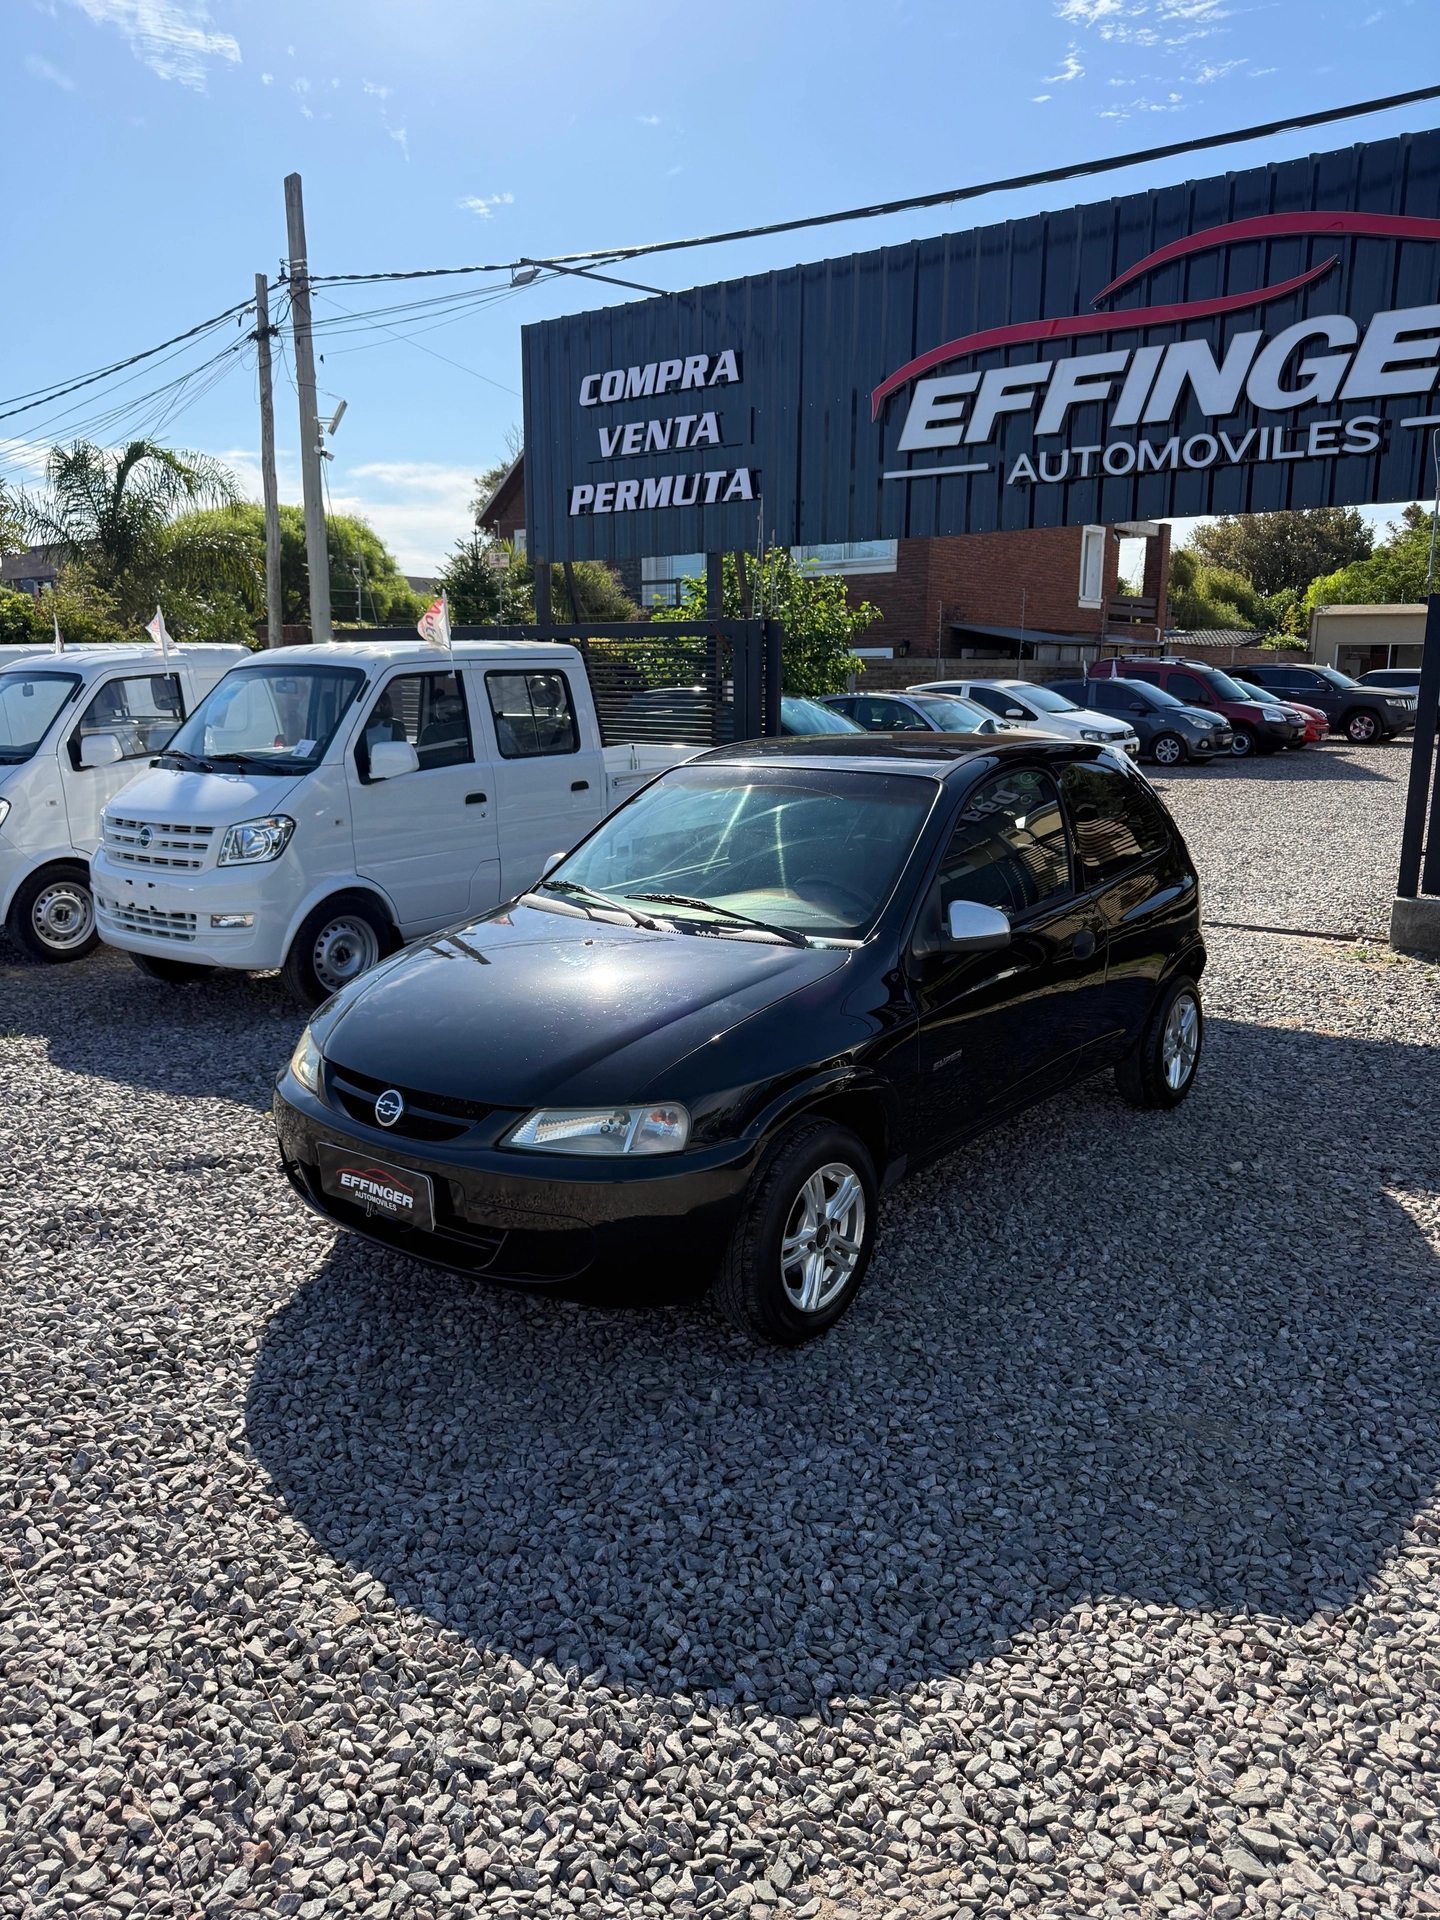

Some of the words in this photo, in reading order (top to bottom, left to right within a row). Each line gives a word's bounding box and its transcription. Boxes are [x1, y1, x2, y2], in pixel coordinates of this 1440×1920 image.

[578, 349, 740, 407] COMPRA
[897, 303, 1440, 451] EFFINGE
[598, 411, 720, 458] VENTA
[1006, 415, 1382, 485] AUTOMOVILES
[568, 467, 754, 516] PERMUTA
[340, 1172, 414, 1209] EFFINGER
[354, 1190, 398, 1212] AUTOMOVILES
